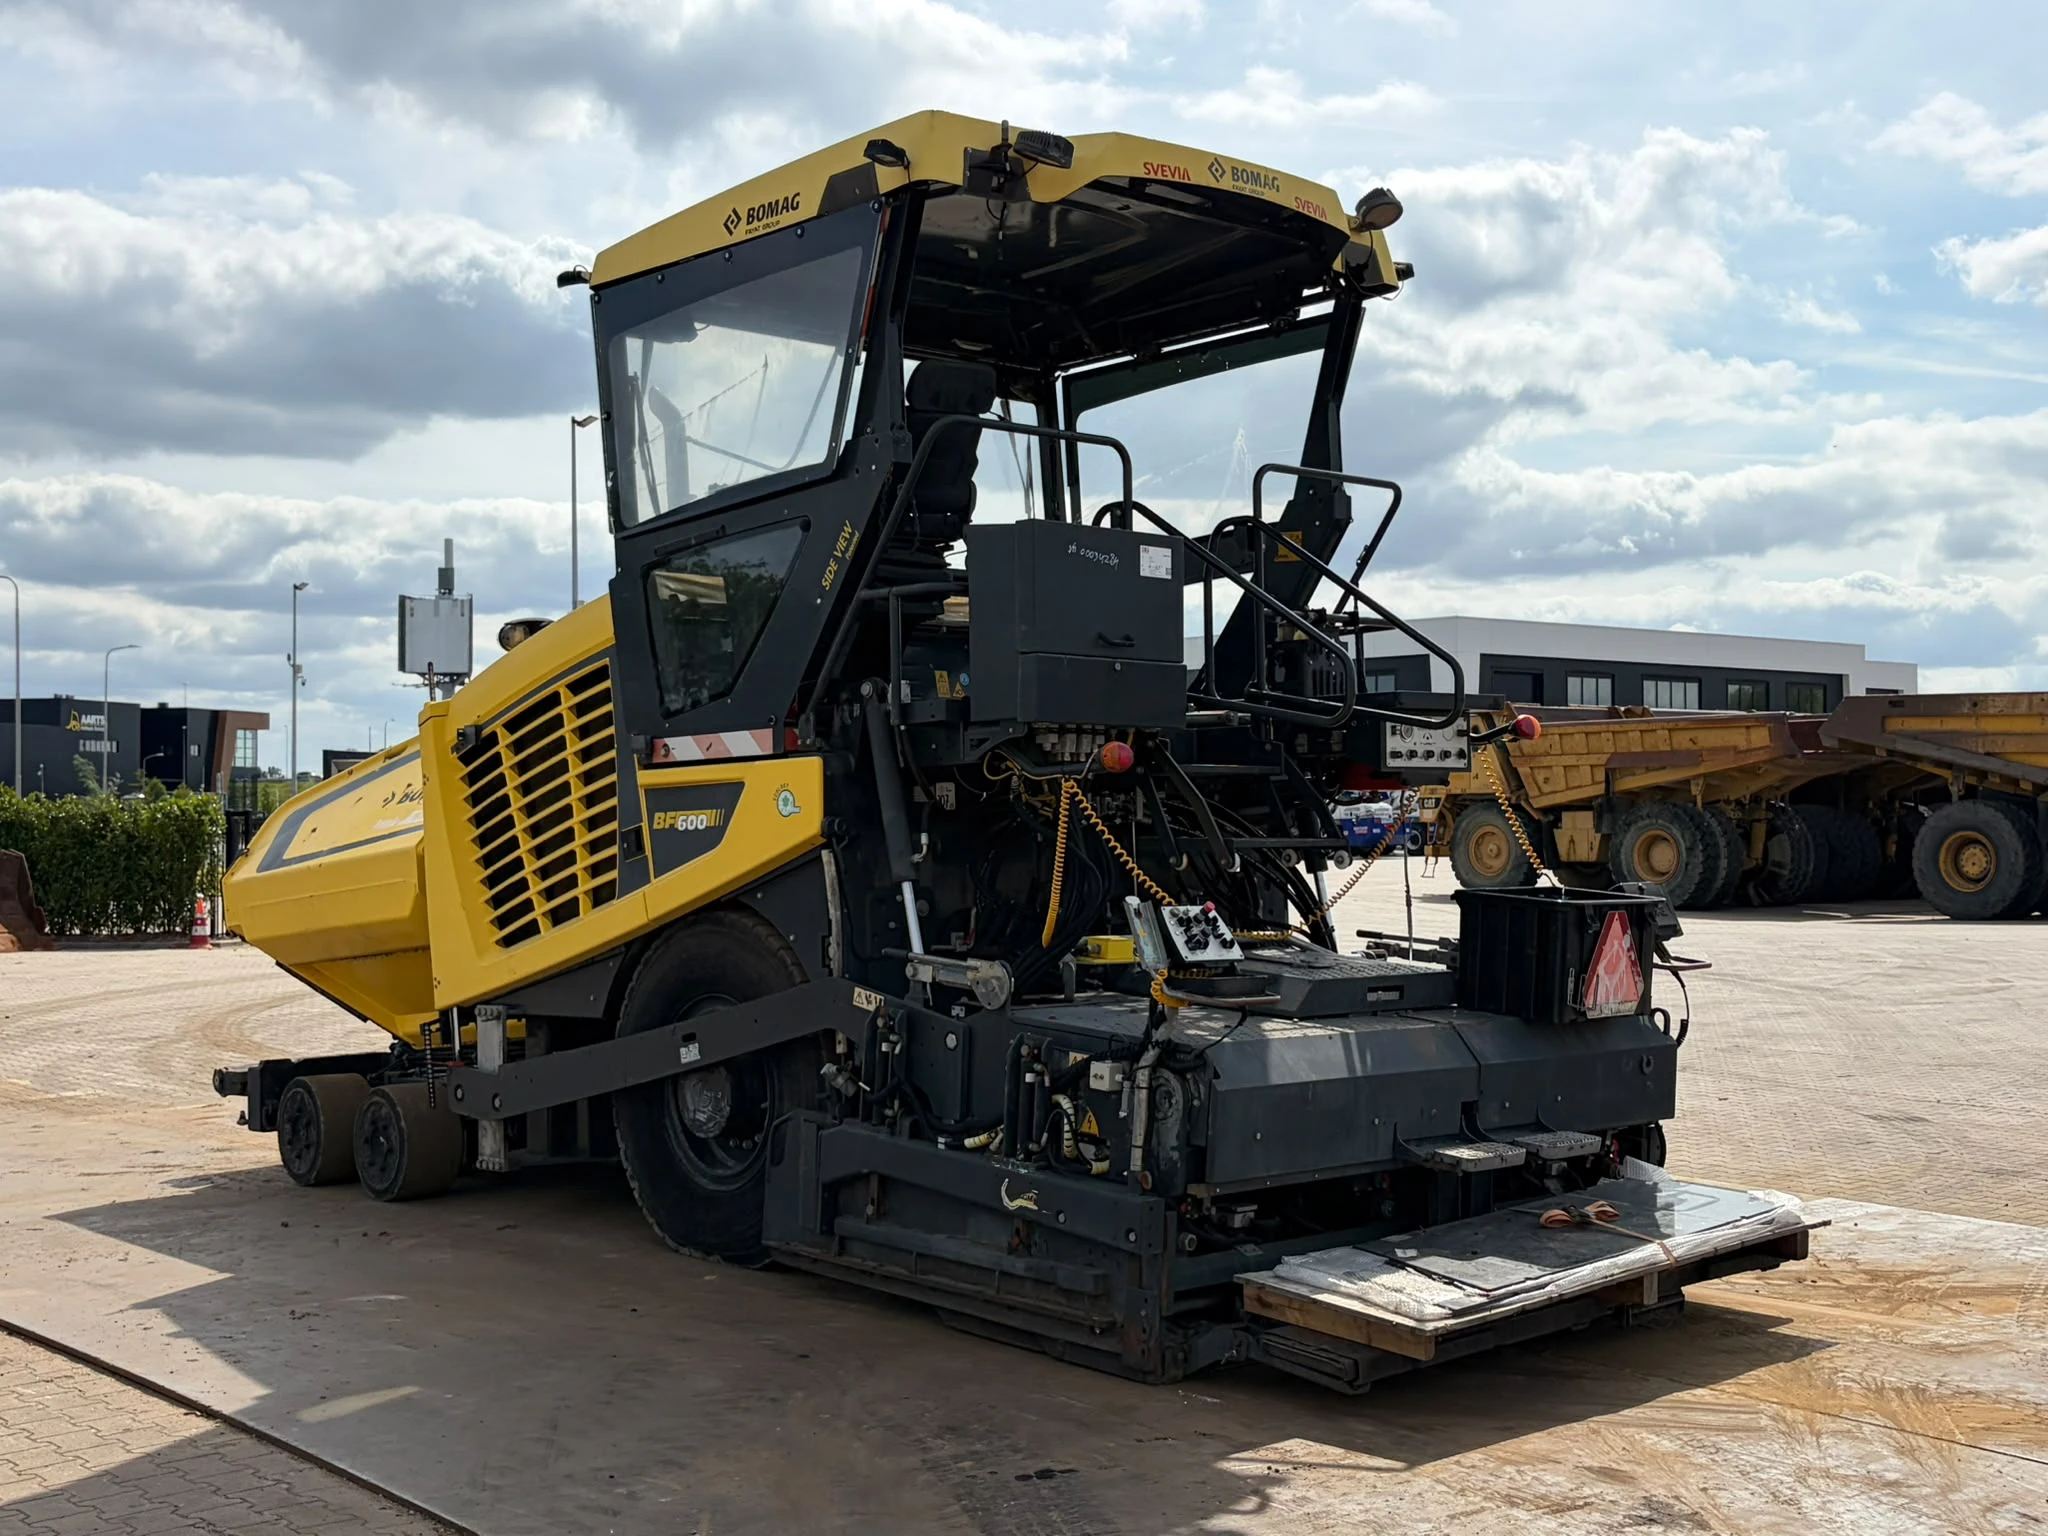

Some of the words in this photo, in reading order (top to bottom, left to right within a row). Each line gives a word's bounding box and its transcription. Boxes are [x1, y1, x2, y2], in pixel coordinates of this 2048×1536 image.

[1143, 162, 1191, 181] SVEVIA
[1231, 166, 1280, 192] BOMAG
[746, 192, 800, 226] BOMAG
[1294, 196, 1328, 220] SVEVIA
[821, 558, 839, 591] SIDE
[833, 519, 852, 558] VIEW
